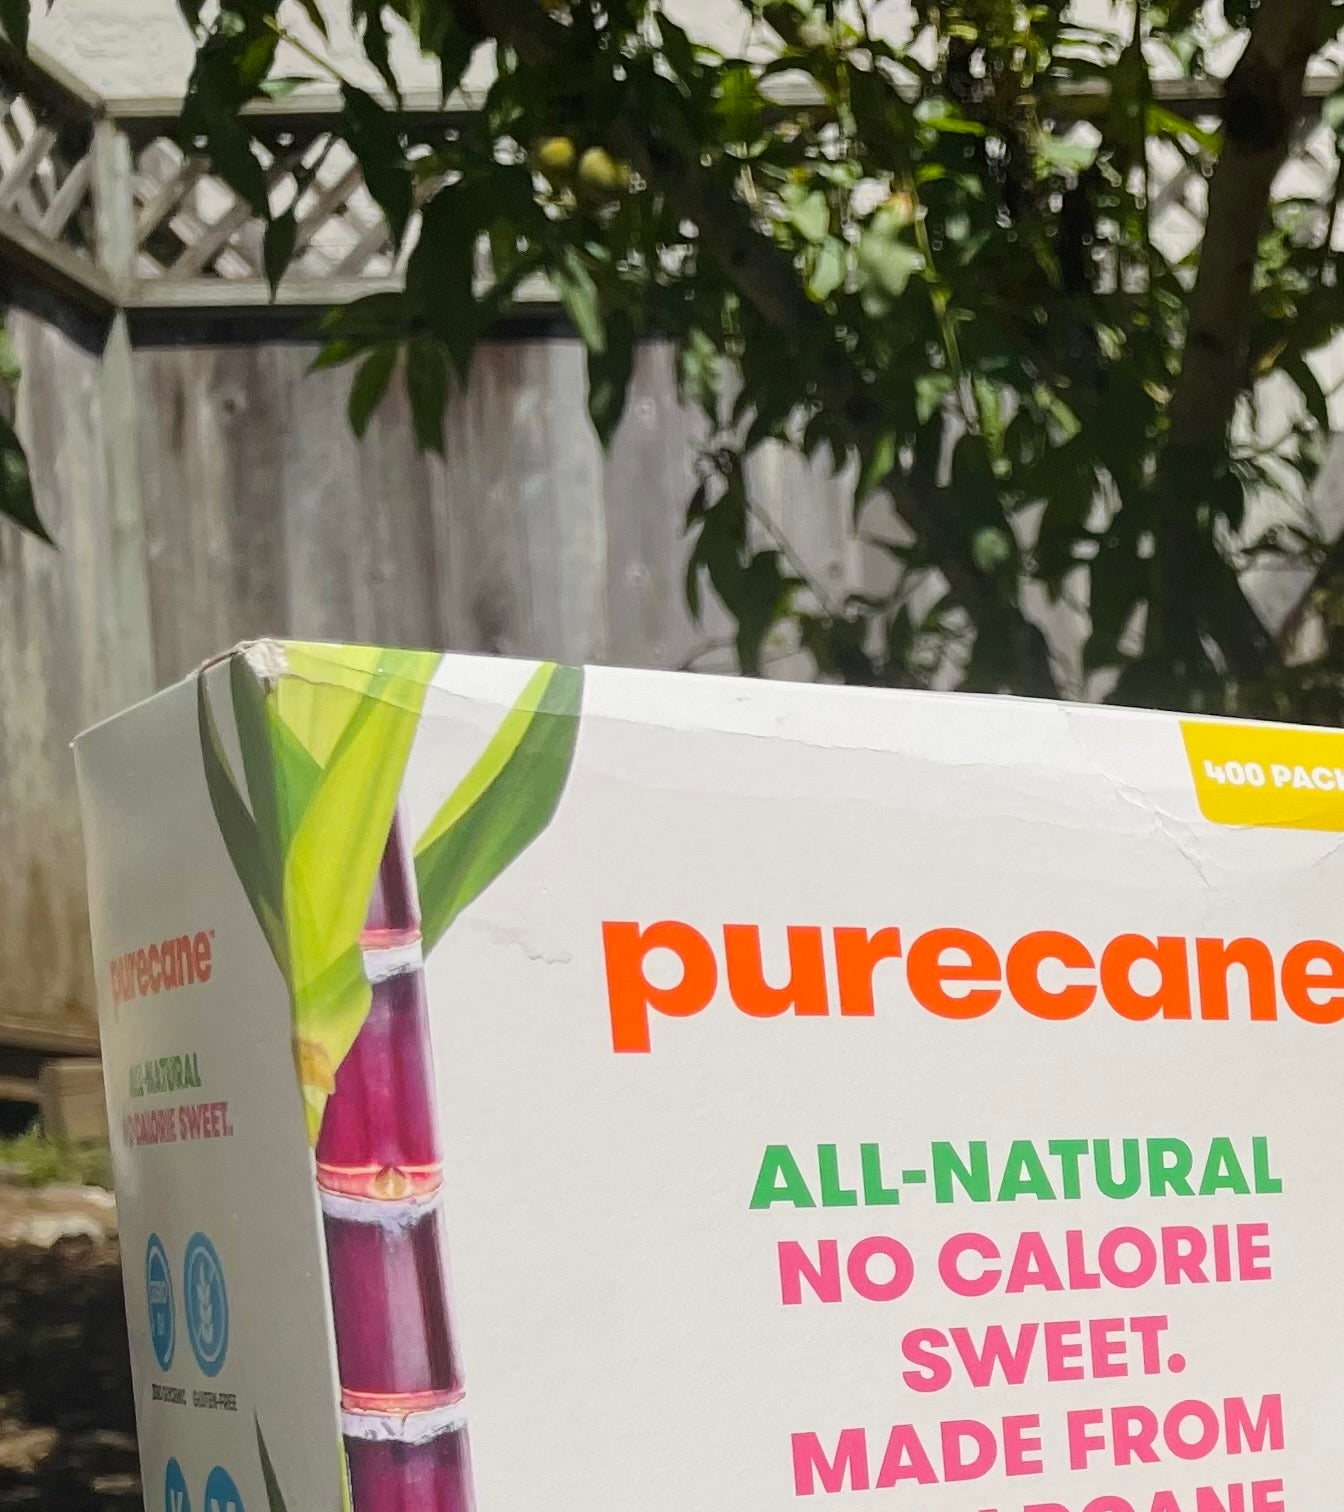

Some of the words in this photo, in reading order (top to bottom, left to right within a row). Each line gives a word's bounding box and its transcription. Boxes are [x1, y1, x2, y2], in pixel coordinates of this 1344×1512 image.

[1203, 760, 1265, 787] 400
[749, 1136, 1282, 1209] ALL-NATURAL
[778, 1236, 914, 1305] NO
[938, 1222, 1271, 1297] CALORIE
[901, 1315, 1186, 1393] SWEET.
[791, 1413, 1043, 1496] MADE
[1067, 1393, 1284, 1470] FROM
